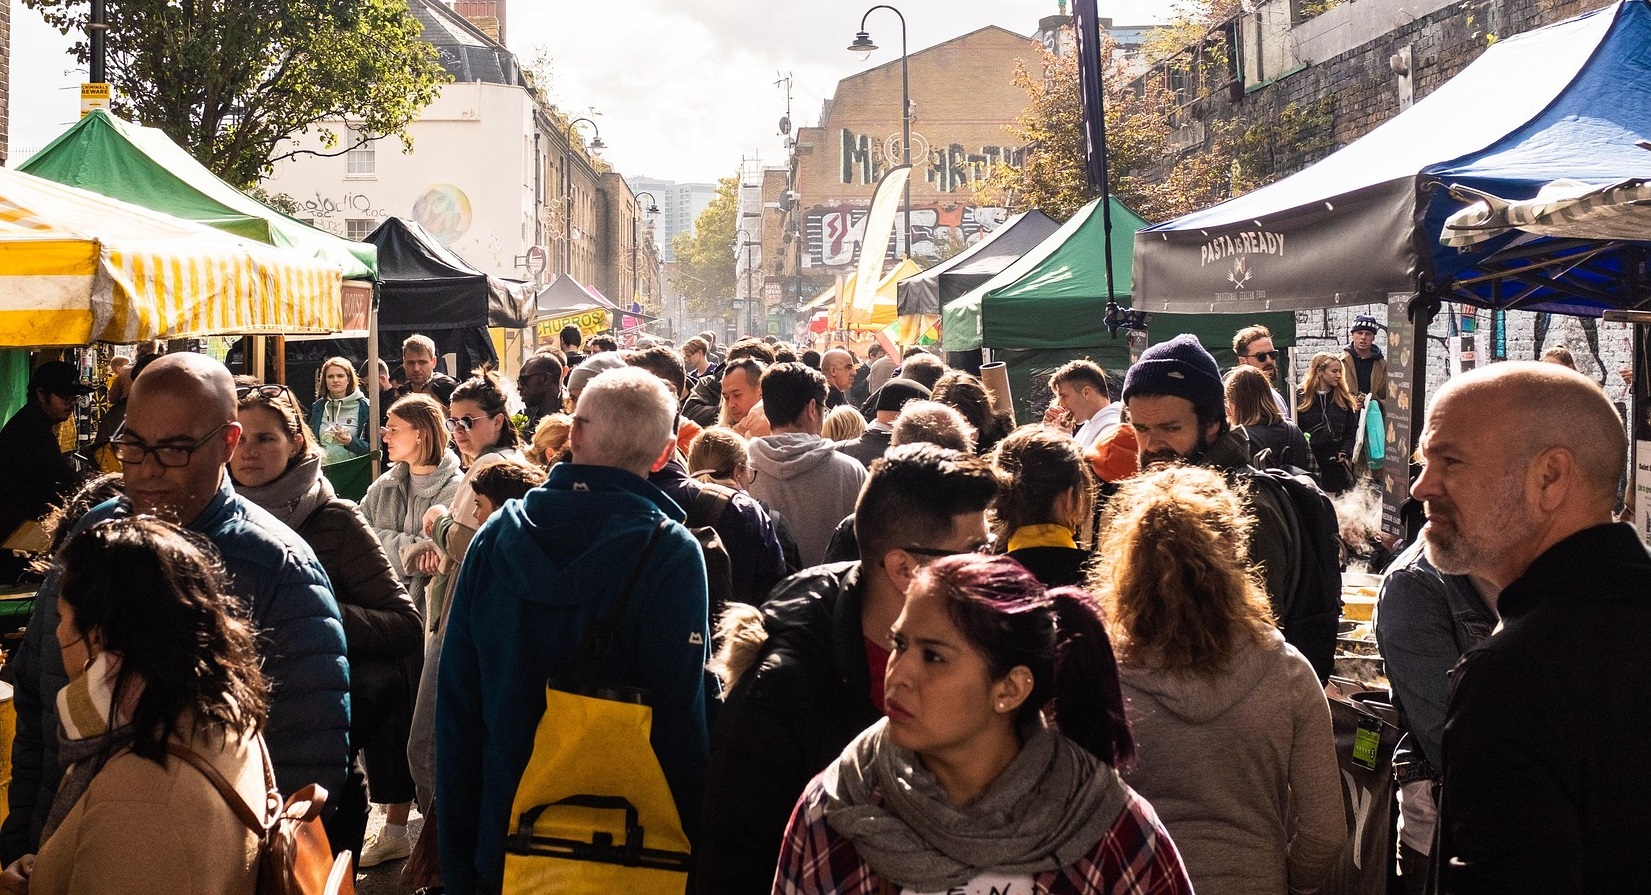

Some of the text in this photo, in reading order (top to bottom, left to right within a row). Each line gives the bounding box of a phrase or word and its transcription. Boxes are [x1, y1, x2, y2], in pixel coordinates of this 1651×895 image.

[1201, 231, 1284, 266] PASTA IS READY
